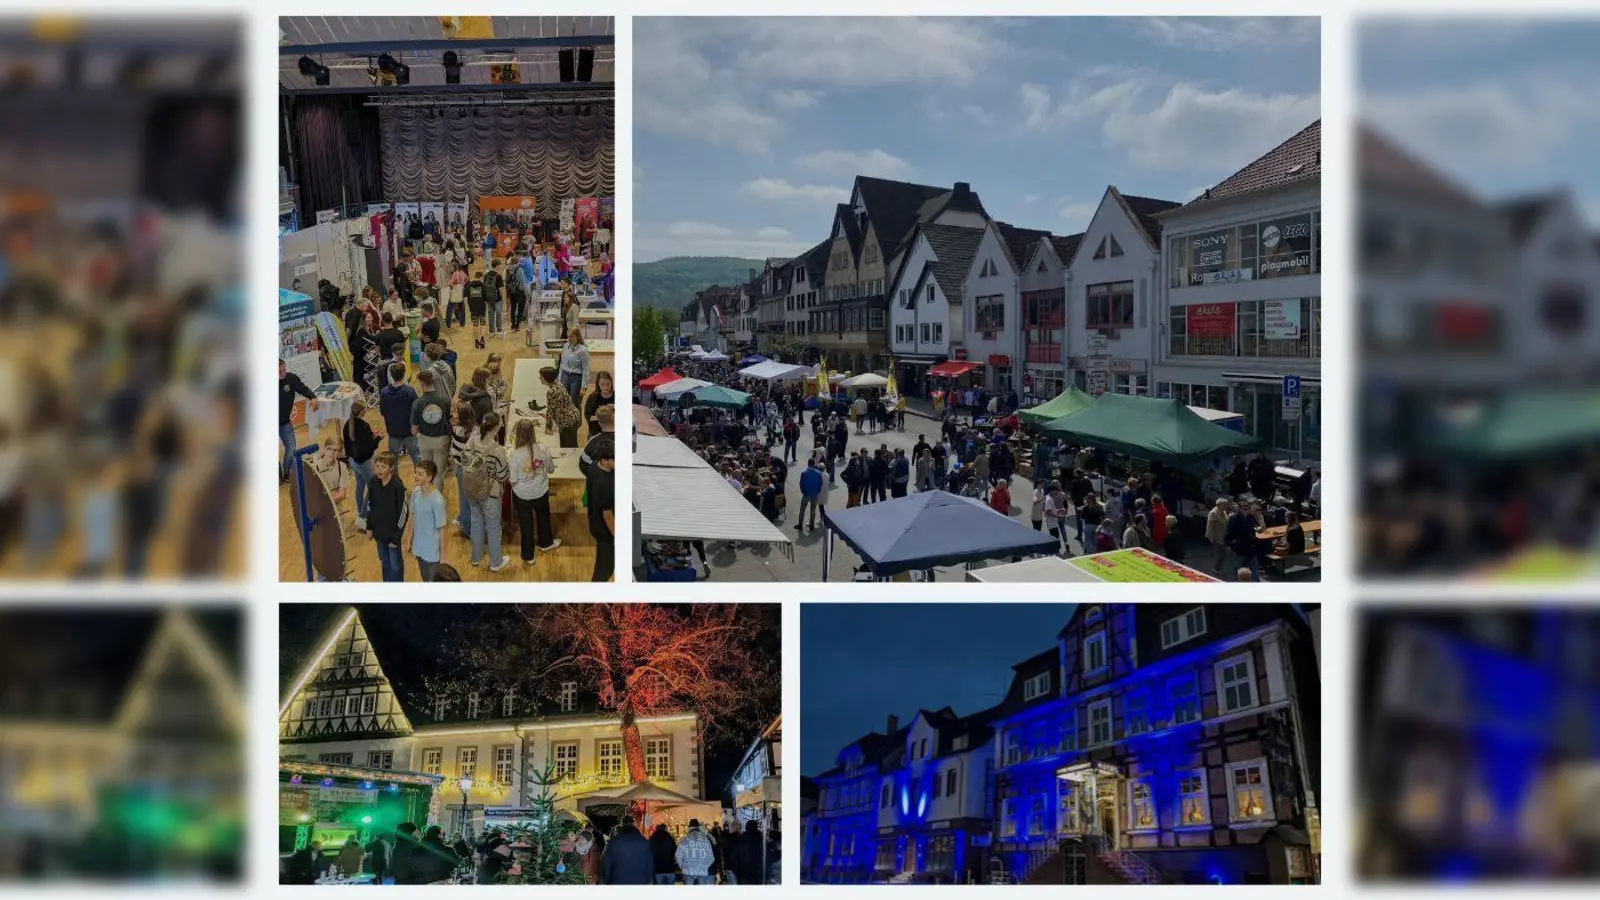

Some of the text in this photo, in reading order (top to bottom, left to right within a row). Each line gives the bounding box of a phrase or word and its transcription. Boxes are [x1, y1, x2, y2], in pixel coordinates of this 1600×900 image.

[1192, 235, 1228, 248] SONY
[1261, 255, 1309, 273] playmobil
[1287, 378, 1297, 394] P
